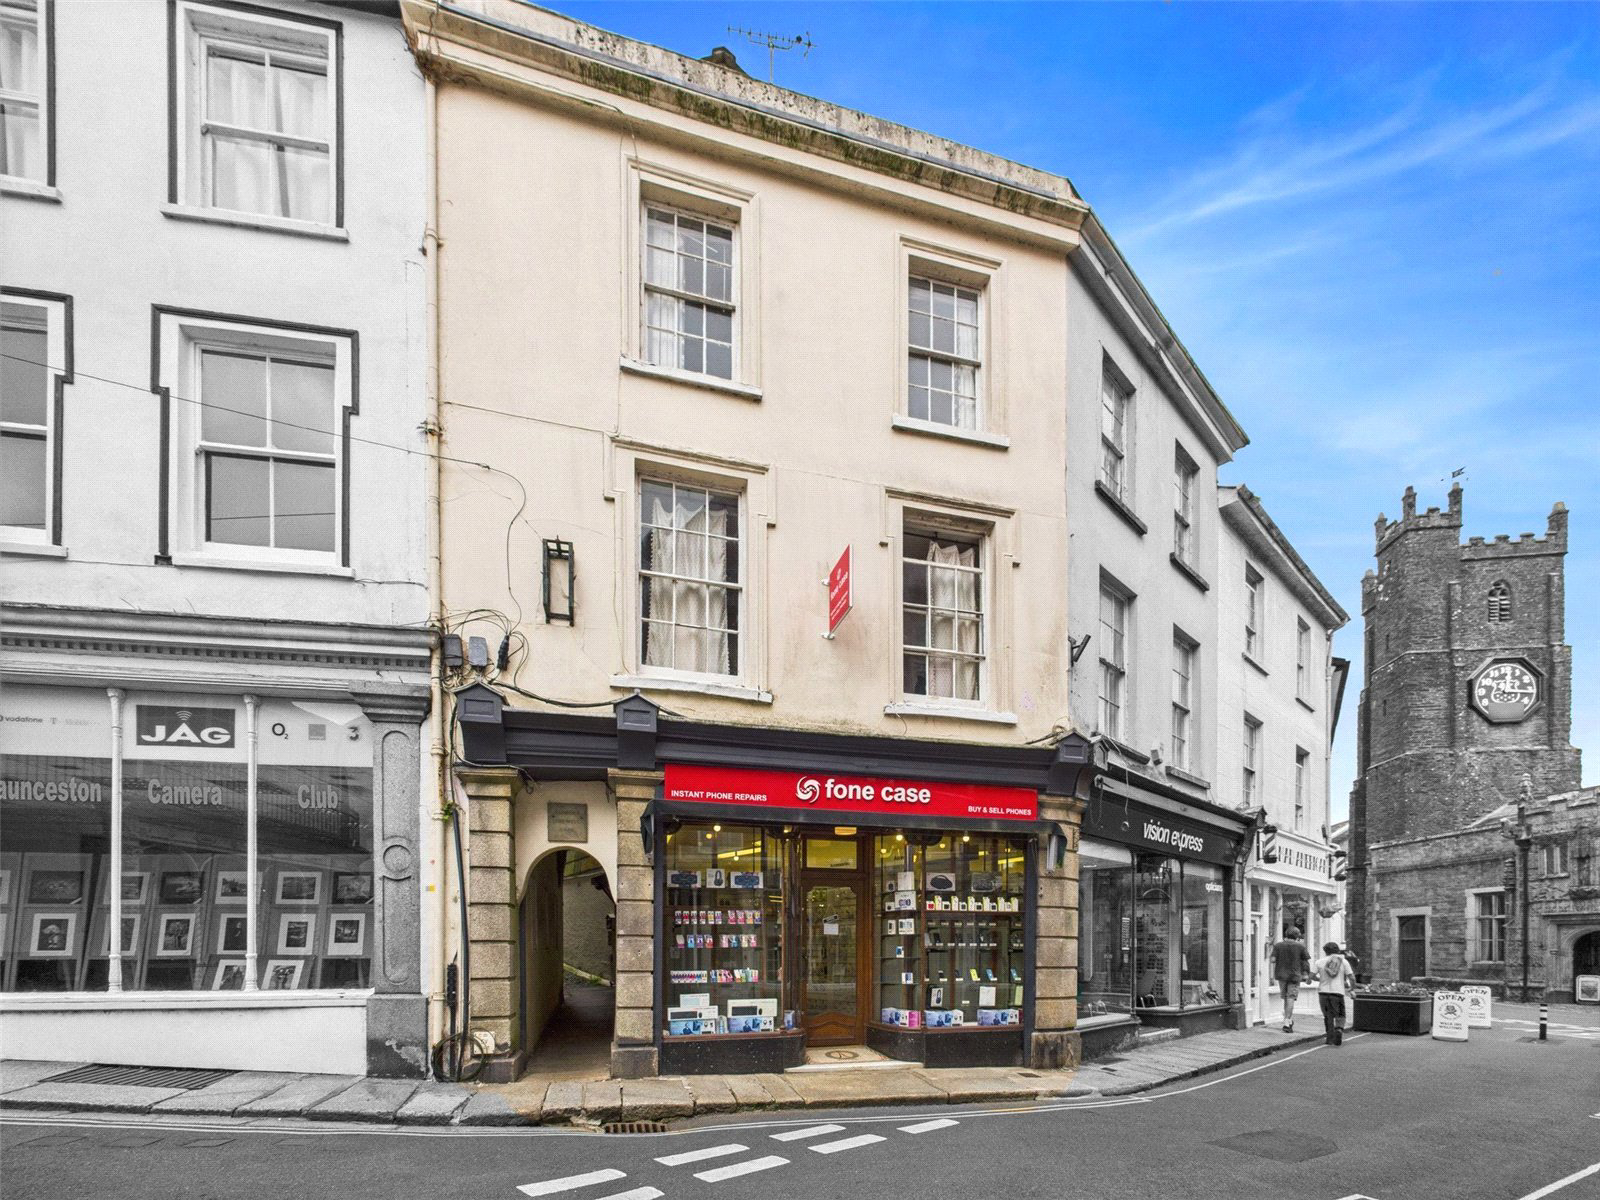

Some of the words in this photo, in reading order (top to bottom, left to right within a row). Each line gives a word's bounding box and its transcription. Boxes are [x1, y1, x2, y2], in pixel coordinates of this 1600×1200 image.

[141, 722, 231, 744] JAG
[348, 726, 359, 741] 3
[148, 779, 222, 805] Camera
[298, 784, 338, 809] Club
[671, 790, 704, 799] INSTANT
[706, 792, 733, 800] PHONE
[735, 793, 767, 801] REPAIRS
[825, 778, 875, 801] fone
[881, 786, 931, 803] case
[968, 805, 981, 813] BUY
[982, 806, 988, 814] &
[1006, 808, 1032, 816] PHONES
[1143, 819, 1170, 843] vision
[1171, 829, 1204, 852] express
[1438, 994, 1466, 1002] OPEN
